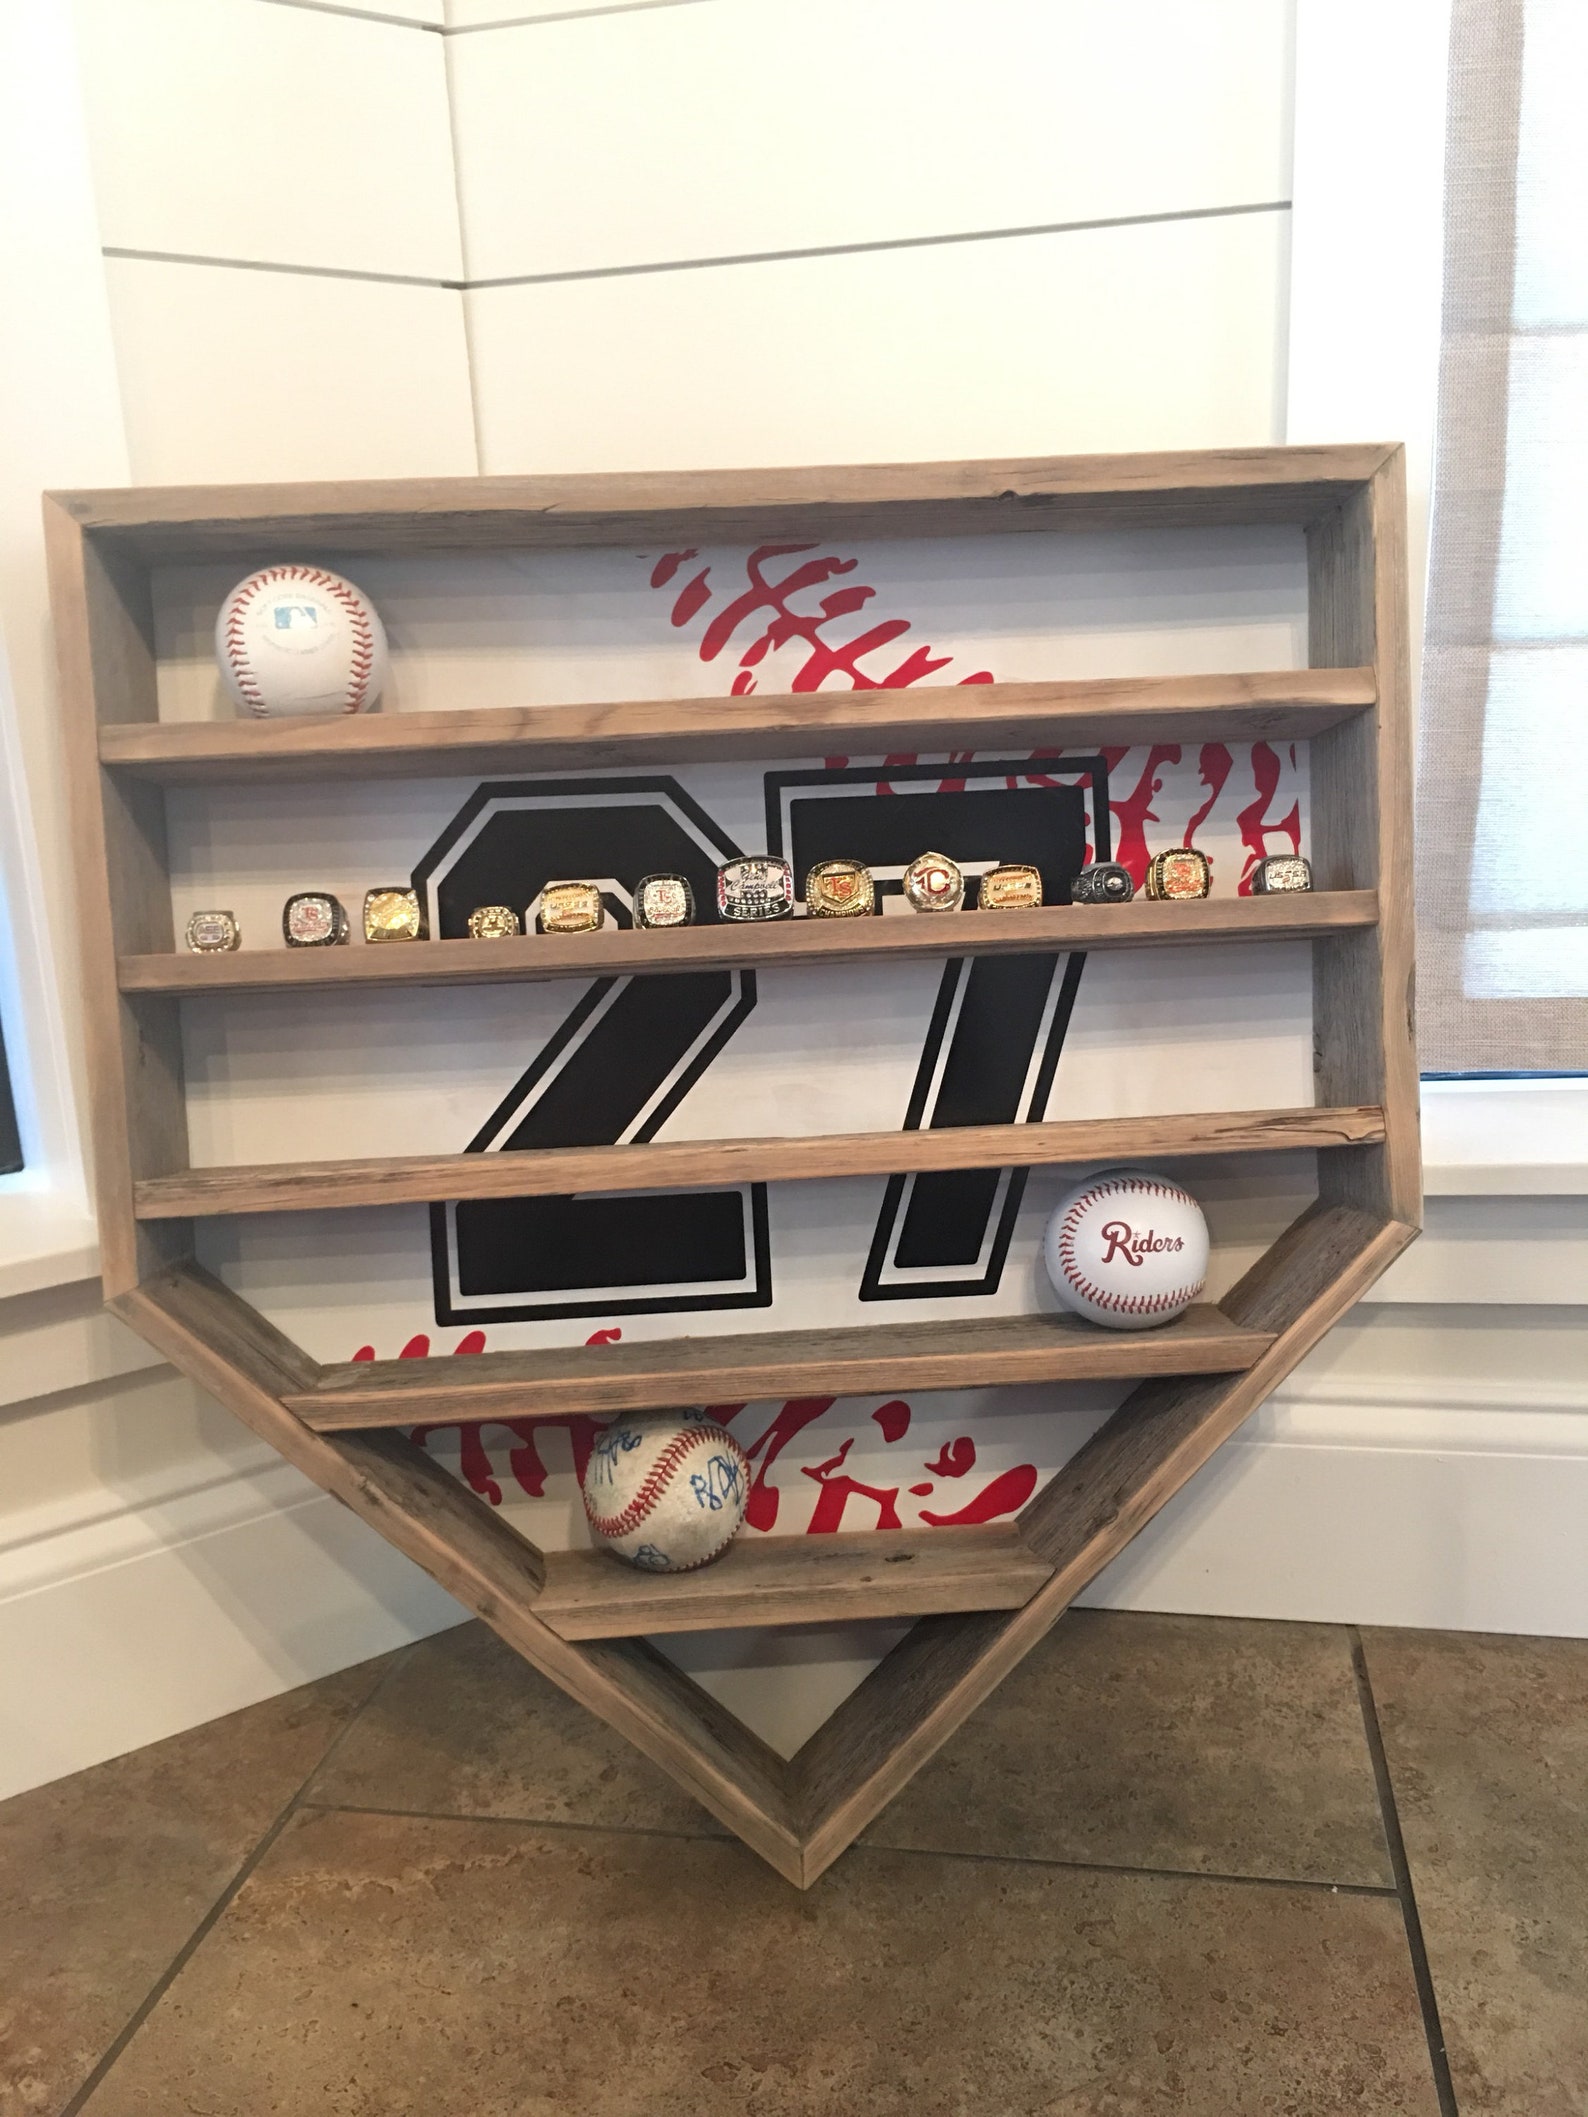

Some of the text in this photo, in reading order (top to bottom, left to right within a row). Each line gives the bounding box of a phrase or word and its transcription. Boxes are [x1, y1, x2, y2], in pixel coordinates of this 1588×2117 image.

[733, 902, 781, 918] SERIES
[411, 757, 1110, 1326] 27
[1101, 1220, 1186, 1267] Riders
